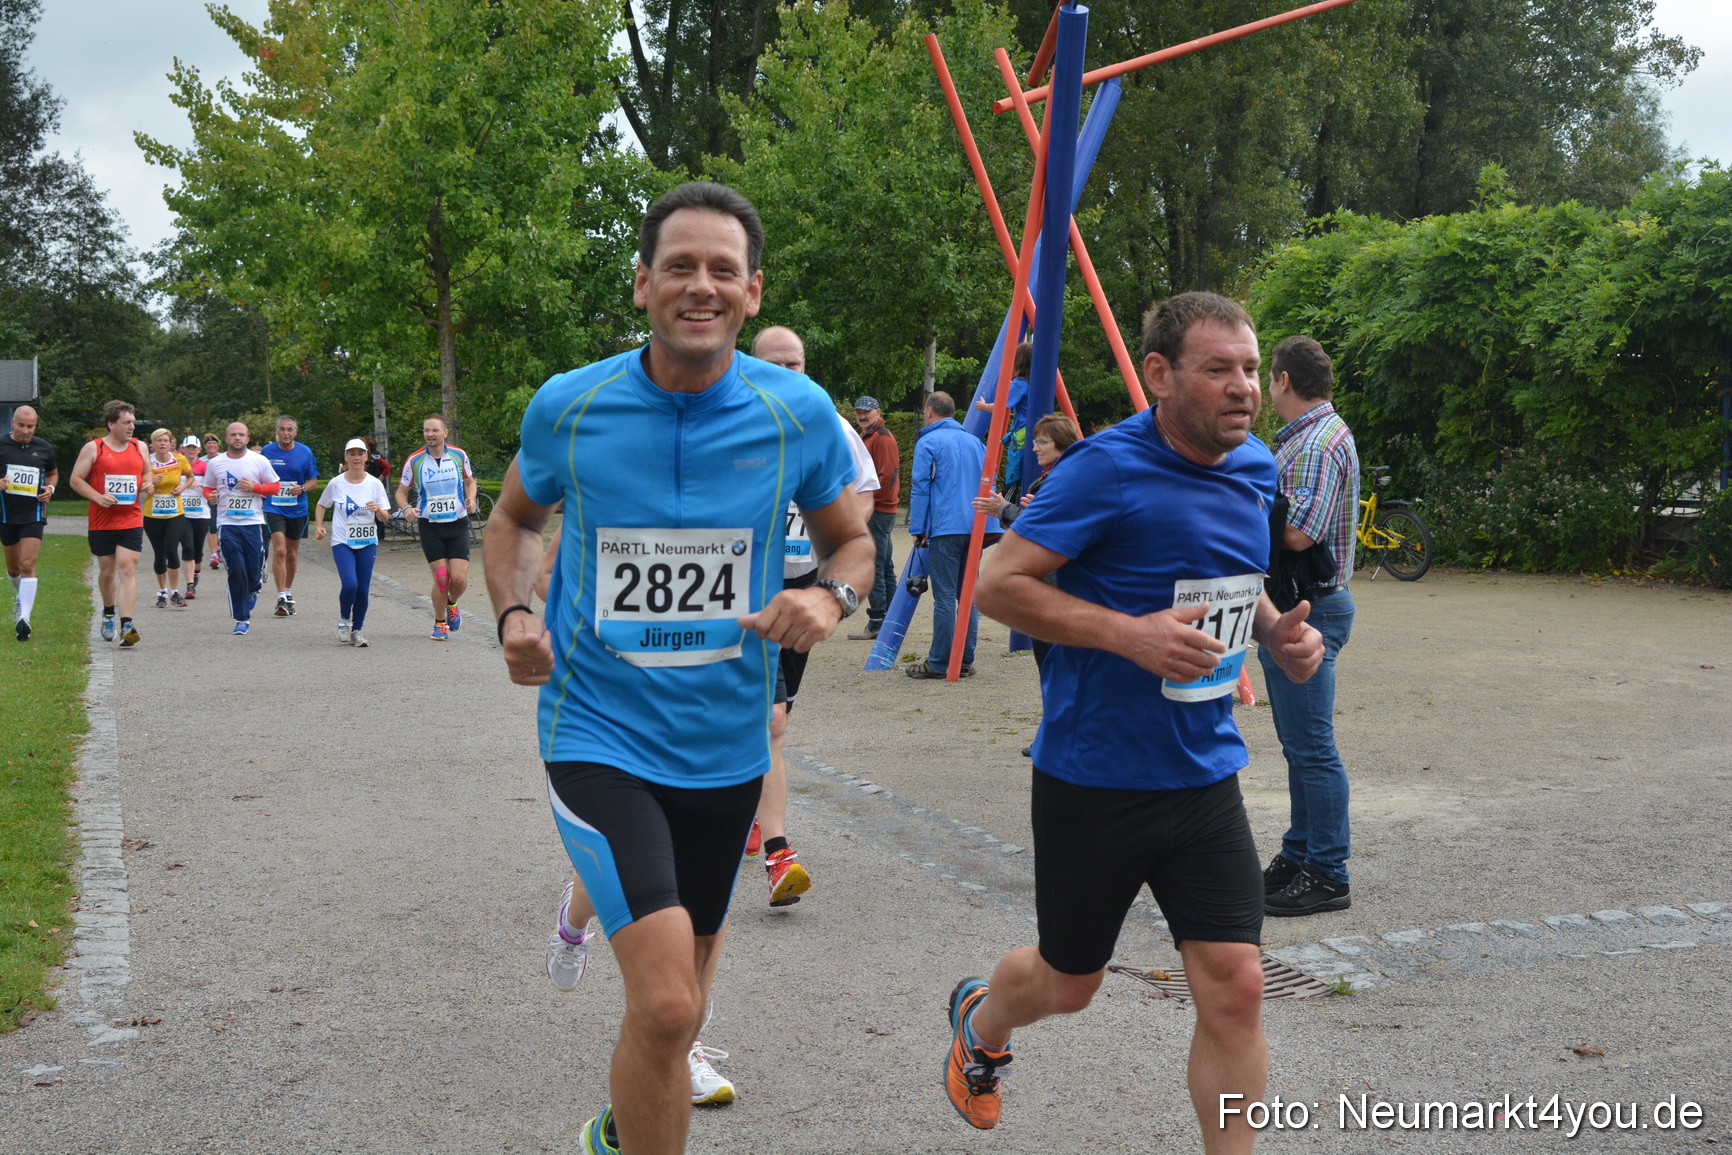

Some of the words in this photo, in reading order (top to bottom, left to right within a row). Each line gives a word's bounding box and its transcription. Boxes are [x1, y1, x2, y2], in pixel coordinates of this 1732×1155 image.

[13, 472, 34, 485] 200
[108, 482, 135, 493] 2216
[155, 499, 176, 509] 2333
[181, 498, 202, 506] 2609
[229, 498, 253, 509] 2827
[430, 501, 455, 513] 2914
[349, 526, 375, 538] 2868
[601, 541, 651, 555] PARTL
[655, 542, 726, 555] Neumarkt
[613, 562, 736, 614] 2824
[1176, 592, 1214, 603] PARTL
[1215, 587, 1255, 602] Neumarkt
[602, 609, 609, 618] D
[640, 628, 706, 650] Jürgen
